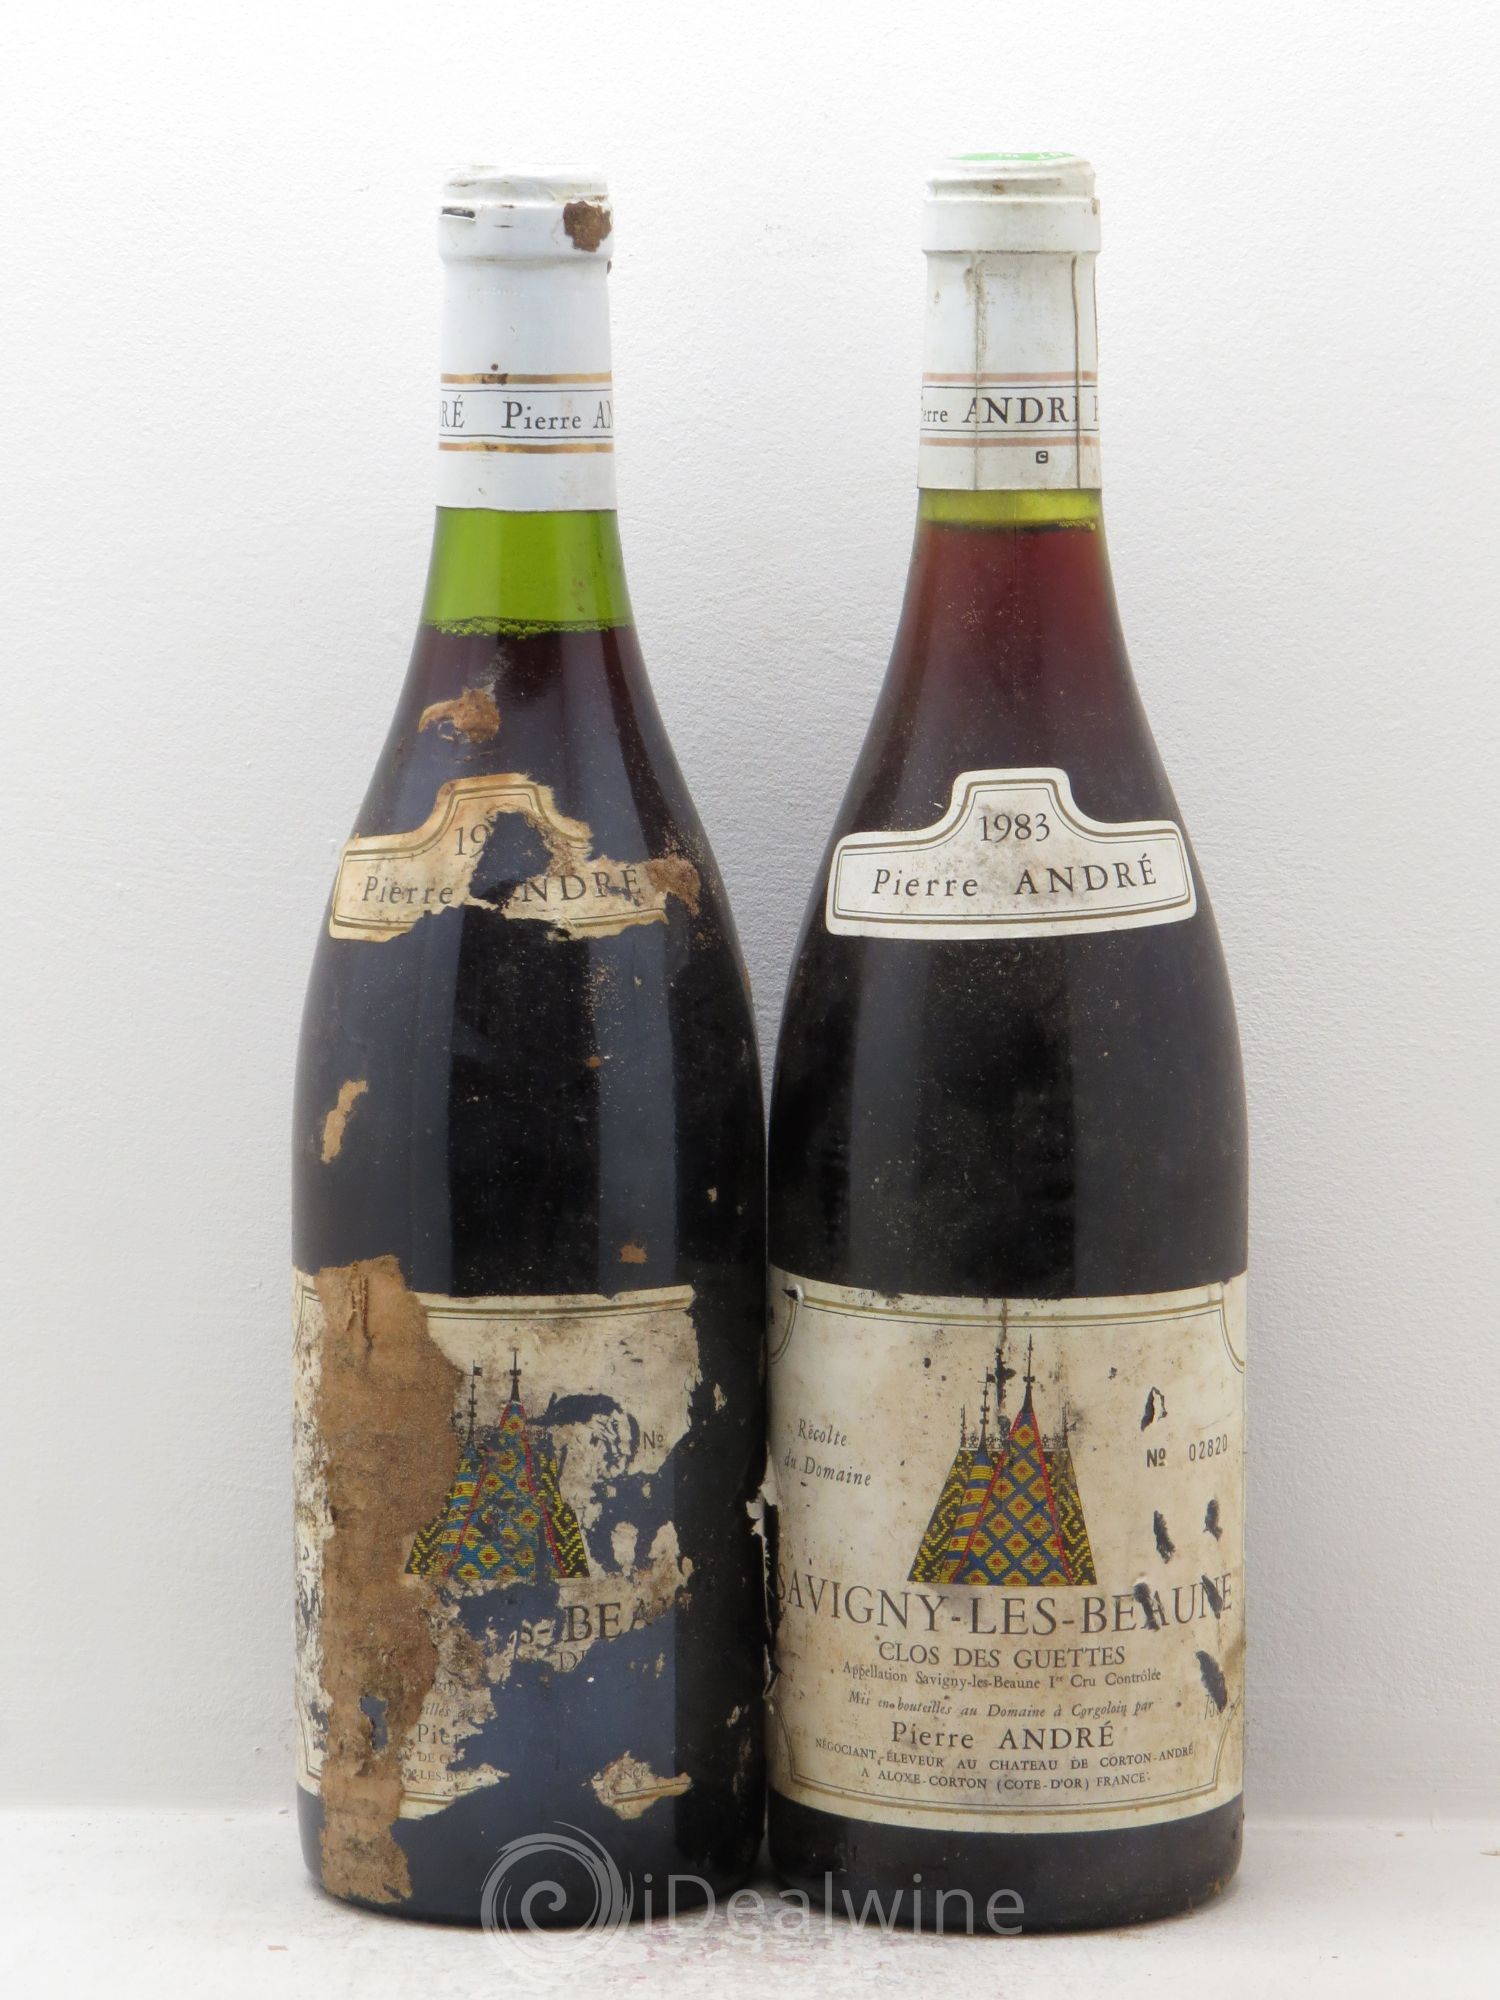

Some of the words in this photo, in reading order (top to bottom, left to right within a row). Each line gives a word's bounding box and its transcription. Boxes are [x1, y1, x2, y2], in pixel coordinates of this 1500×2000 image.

[501, 400, 582, 430] Pierre
[978, 812, 1051, 843] 1983
[362, 874, 454, 905] Pierre
[872, 868, 979, 897] Pierre
[1014, 852, 1157, 896] ANDRÉ
[798, 1418, 848, 1447] Récolte
[1189, 1433, 1228, 1462] 02820
[784, 1447, 797, 1470] du
[804, 1455, 872, 1487] Domaine
[878, 1641, 941, 1666] CLOS
[953, 1647, 1001, 1669] DES
[1013, 1645, 1126, 1669] GUETTES
[843, 1661, 908, 1684] Appellation
[915, 1670, 1040, 1692] Savigny-les-Beaune
[1070, 1673, 1096, 1688] Cru
[848, 1690, 871, 1706] Mis
[960, 1705, 978, 1718] au
[987, 1703, 1046, 1719] Domaine
[1053, 1703, 1062, 1717] à
[1132, 1698, 1155, 1717] par
[891, 1721, 974, 1749] Pierre
[998, 1720, 1115, 1750] ANDRÉ
[957, 1758, 978, 1771] AU
[989, 1758, 1058, 1771] CHATEAU
[1070, 1757, 1089, 1770] DE
